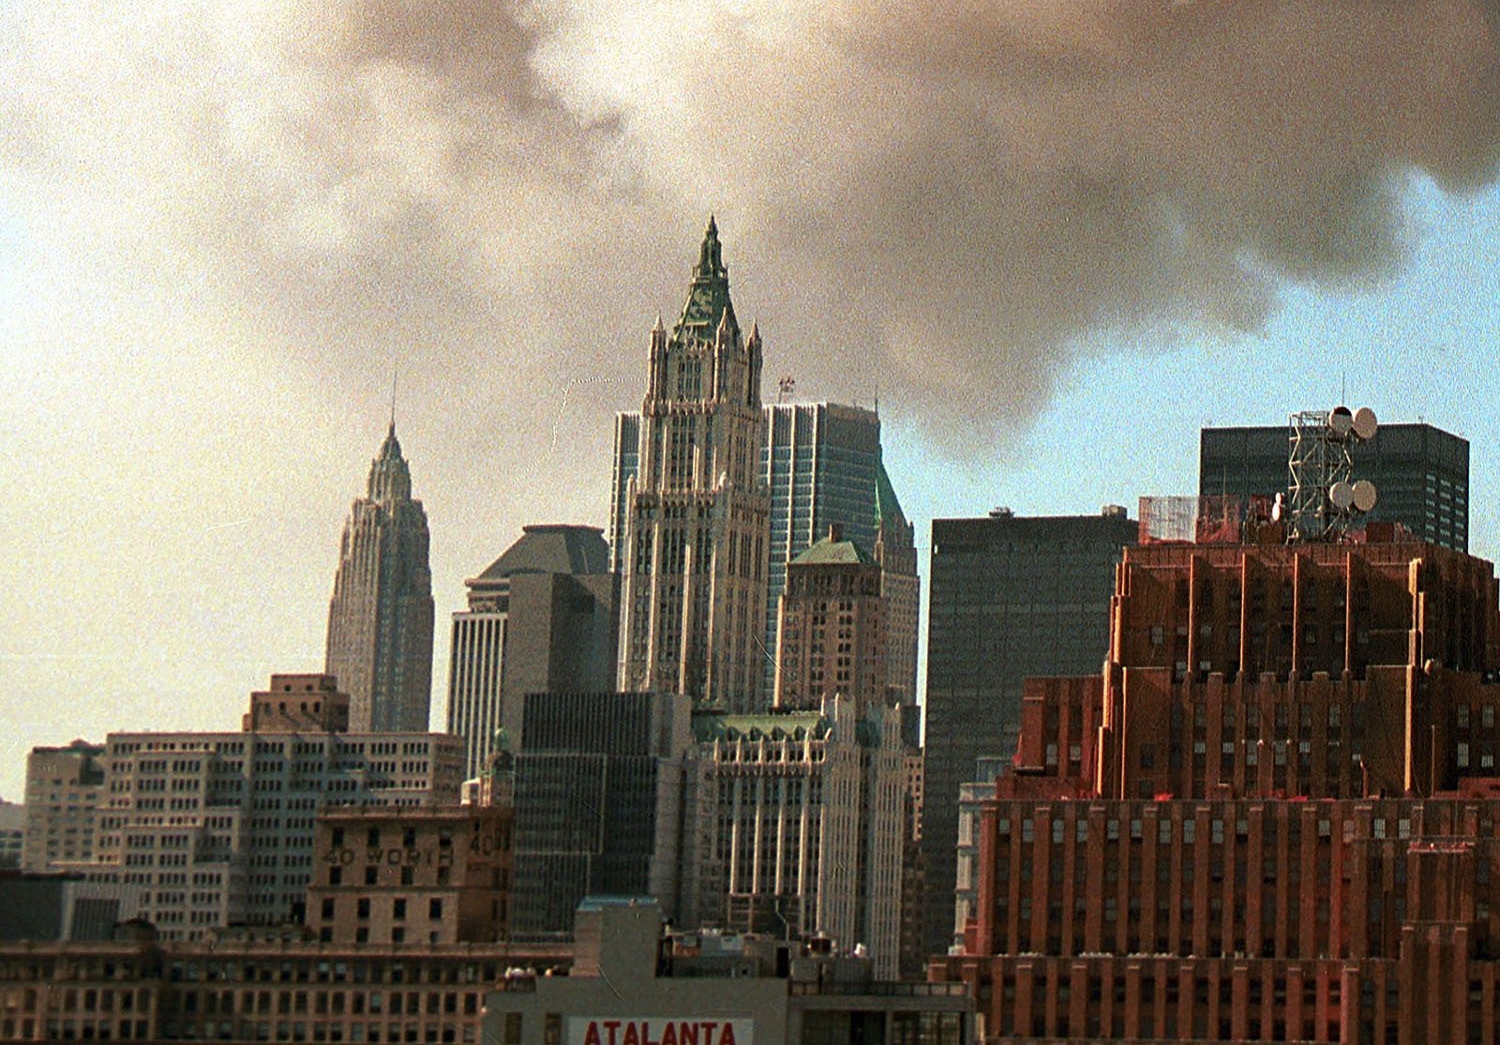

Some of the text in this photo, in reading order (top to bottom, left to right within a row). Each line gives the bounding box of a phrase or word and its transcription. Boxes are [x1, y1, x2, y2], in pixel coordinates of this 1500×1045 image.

[322, 847, 454, 866] 40 WORTH
[584, 1021, 737, 1045] ATALANTA
